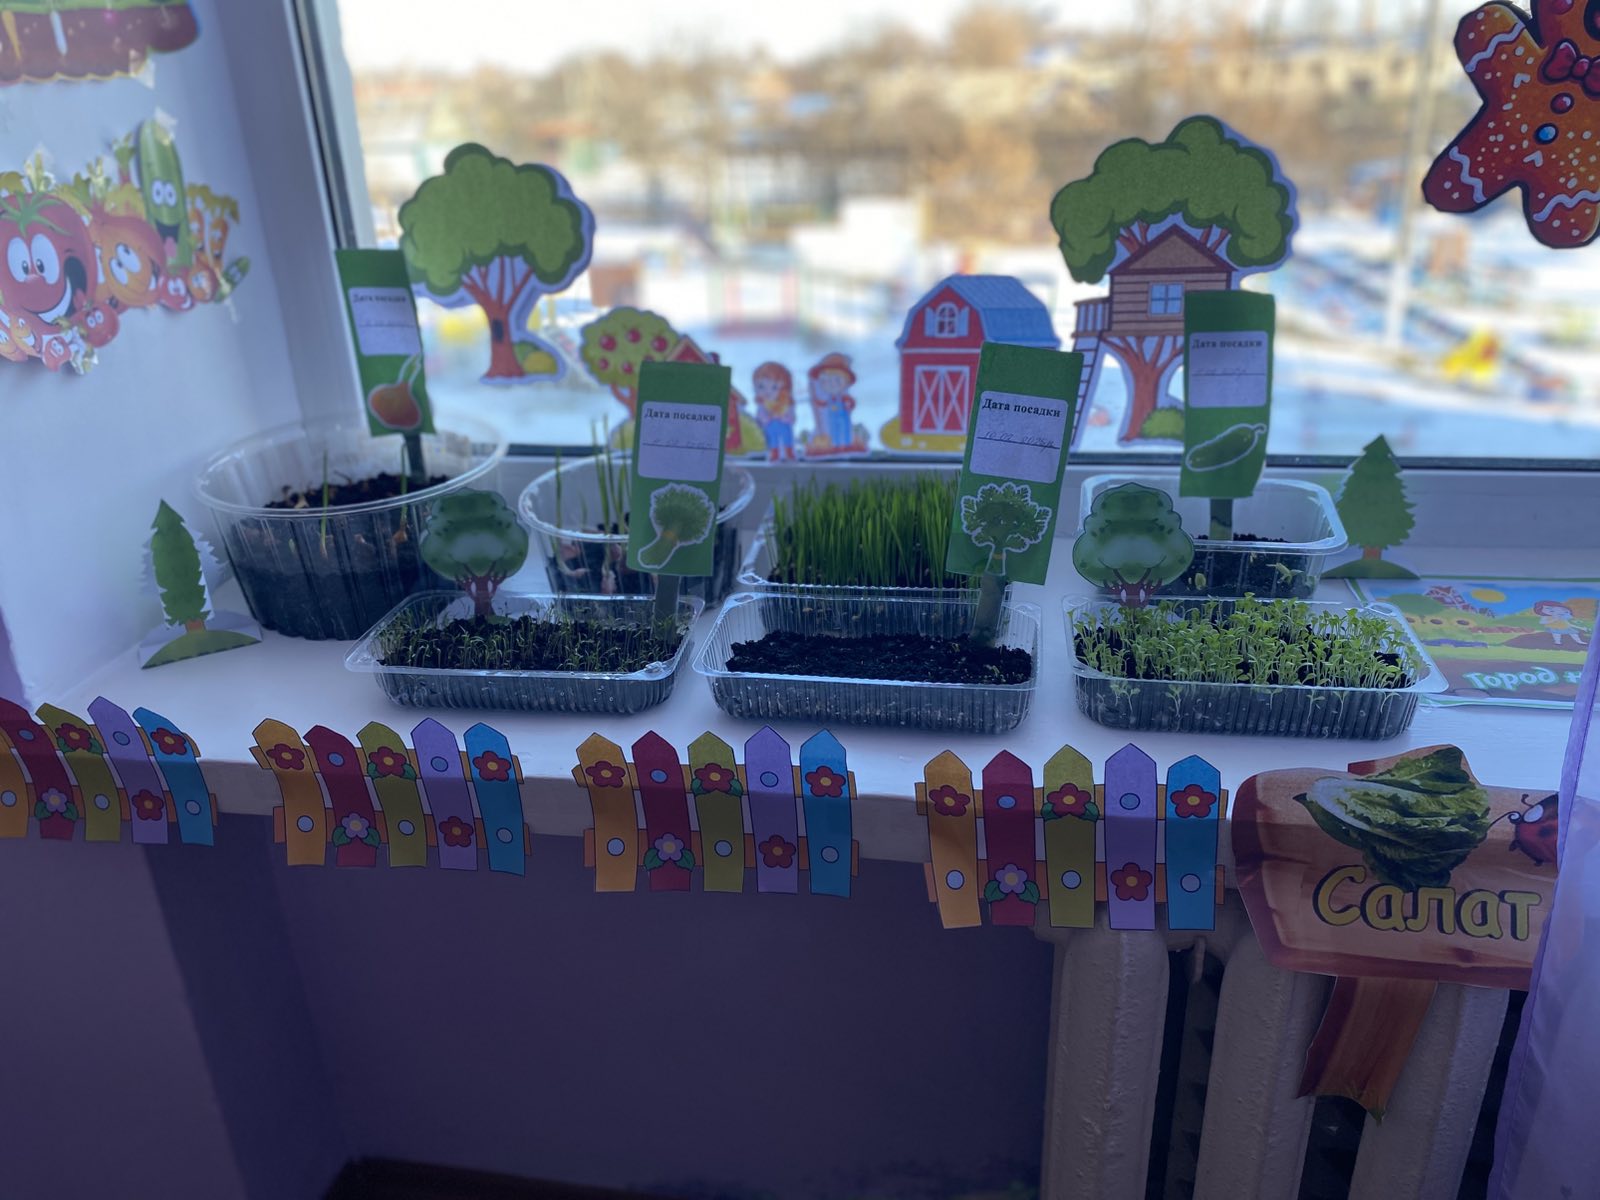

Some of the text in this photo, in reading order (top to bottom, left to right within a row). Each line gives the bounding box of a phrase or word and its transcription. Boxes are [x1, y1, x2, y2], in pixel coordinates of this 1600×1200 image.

[643, 407, 716, 422] Дата посадки
[982, 398, 1061, 418] Дата посадки
[1312, 864, 1542, 941] Салат
